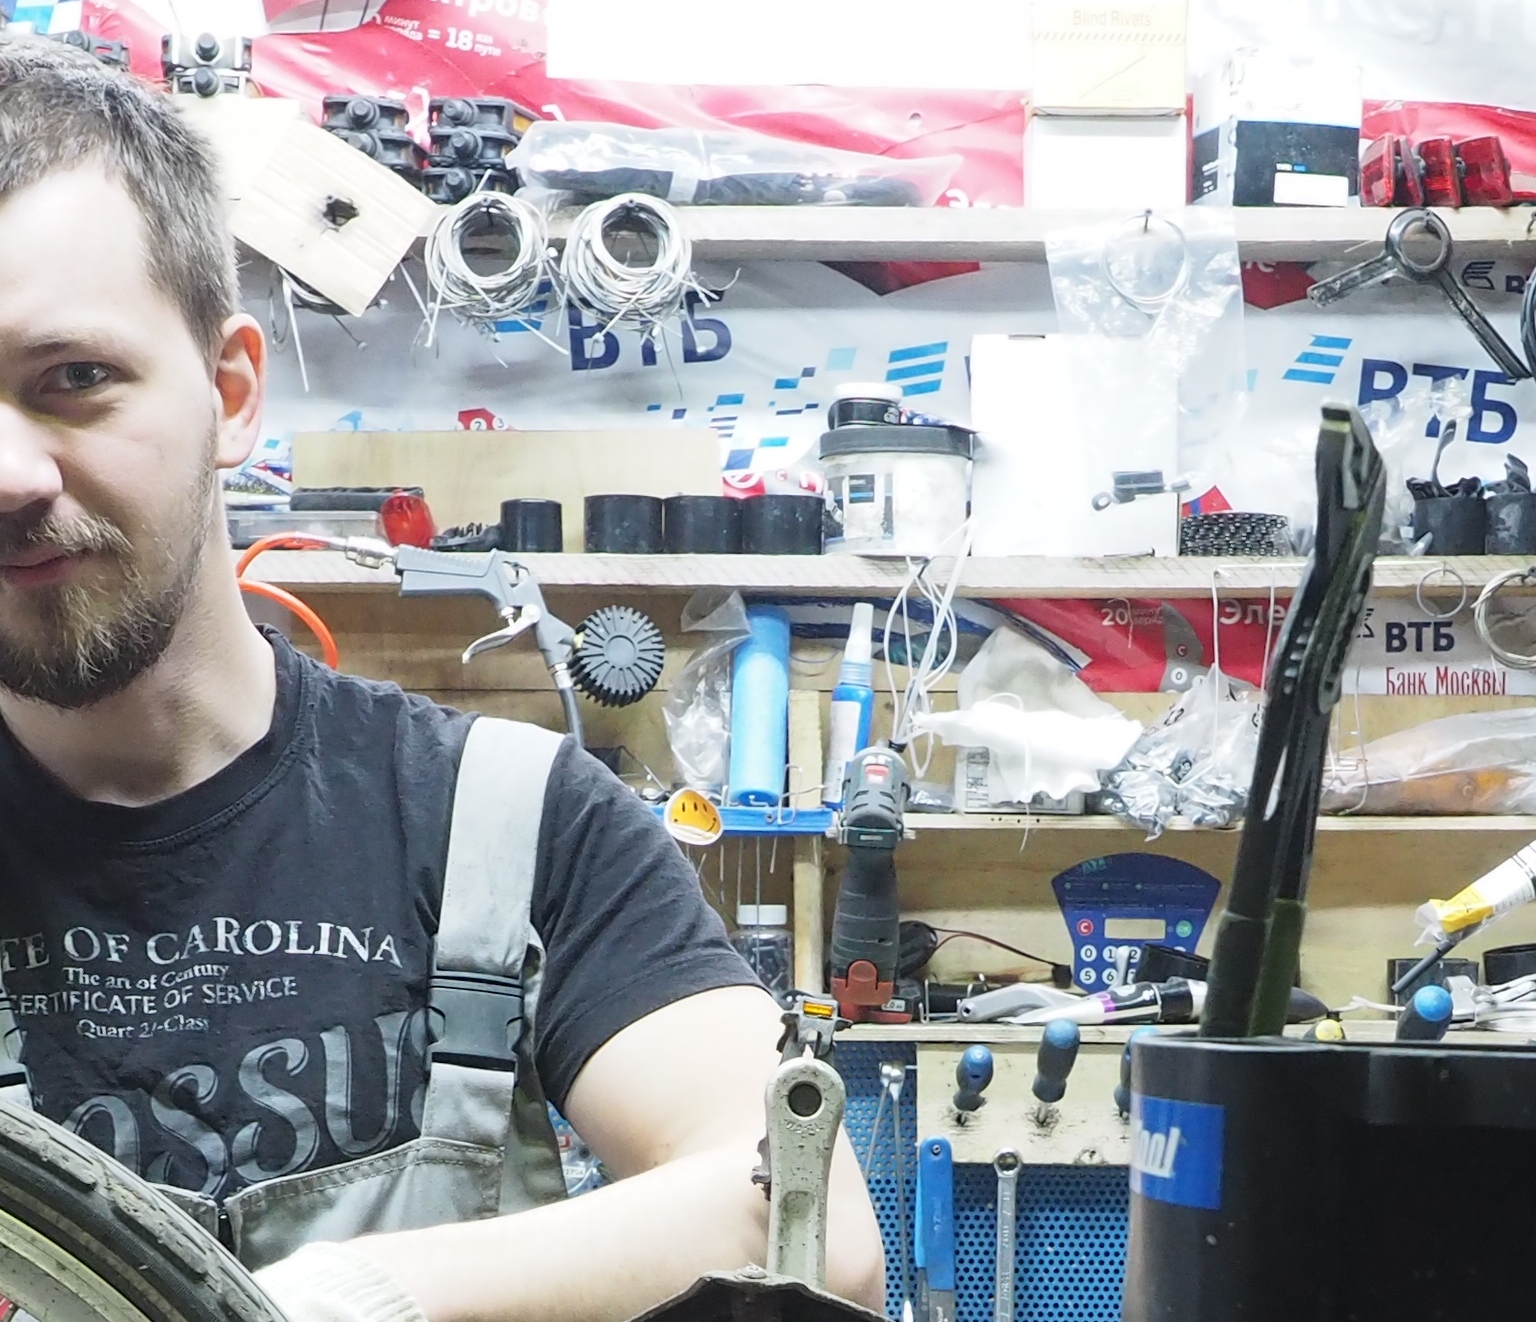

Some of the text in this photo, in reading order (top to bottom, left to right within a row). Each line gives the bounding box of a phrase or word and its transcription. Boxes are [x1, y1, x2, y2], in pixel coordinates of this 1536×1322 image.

[445, 28, 473, 50] 18
[1356, 357, 1519, 444] ВТБ
[1101, 608, 1128, 627] 20
[1385, 622, 1455, 652] ВТБ
[1385, 667, 1507, 694] Банк Москвы
[63, 925, 130, 964] OF
[146, 916, 403, 969] CAROLINA
[63, 967, 101, 986] The
[135, 973, 157, 990] of
[160, 962, 230, 988] Century
[163, 988, 193, 1008] OF
[202, 976, 298, 1005] SERVICE
[76, 1018, 133, 1038] Quart
